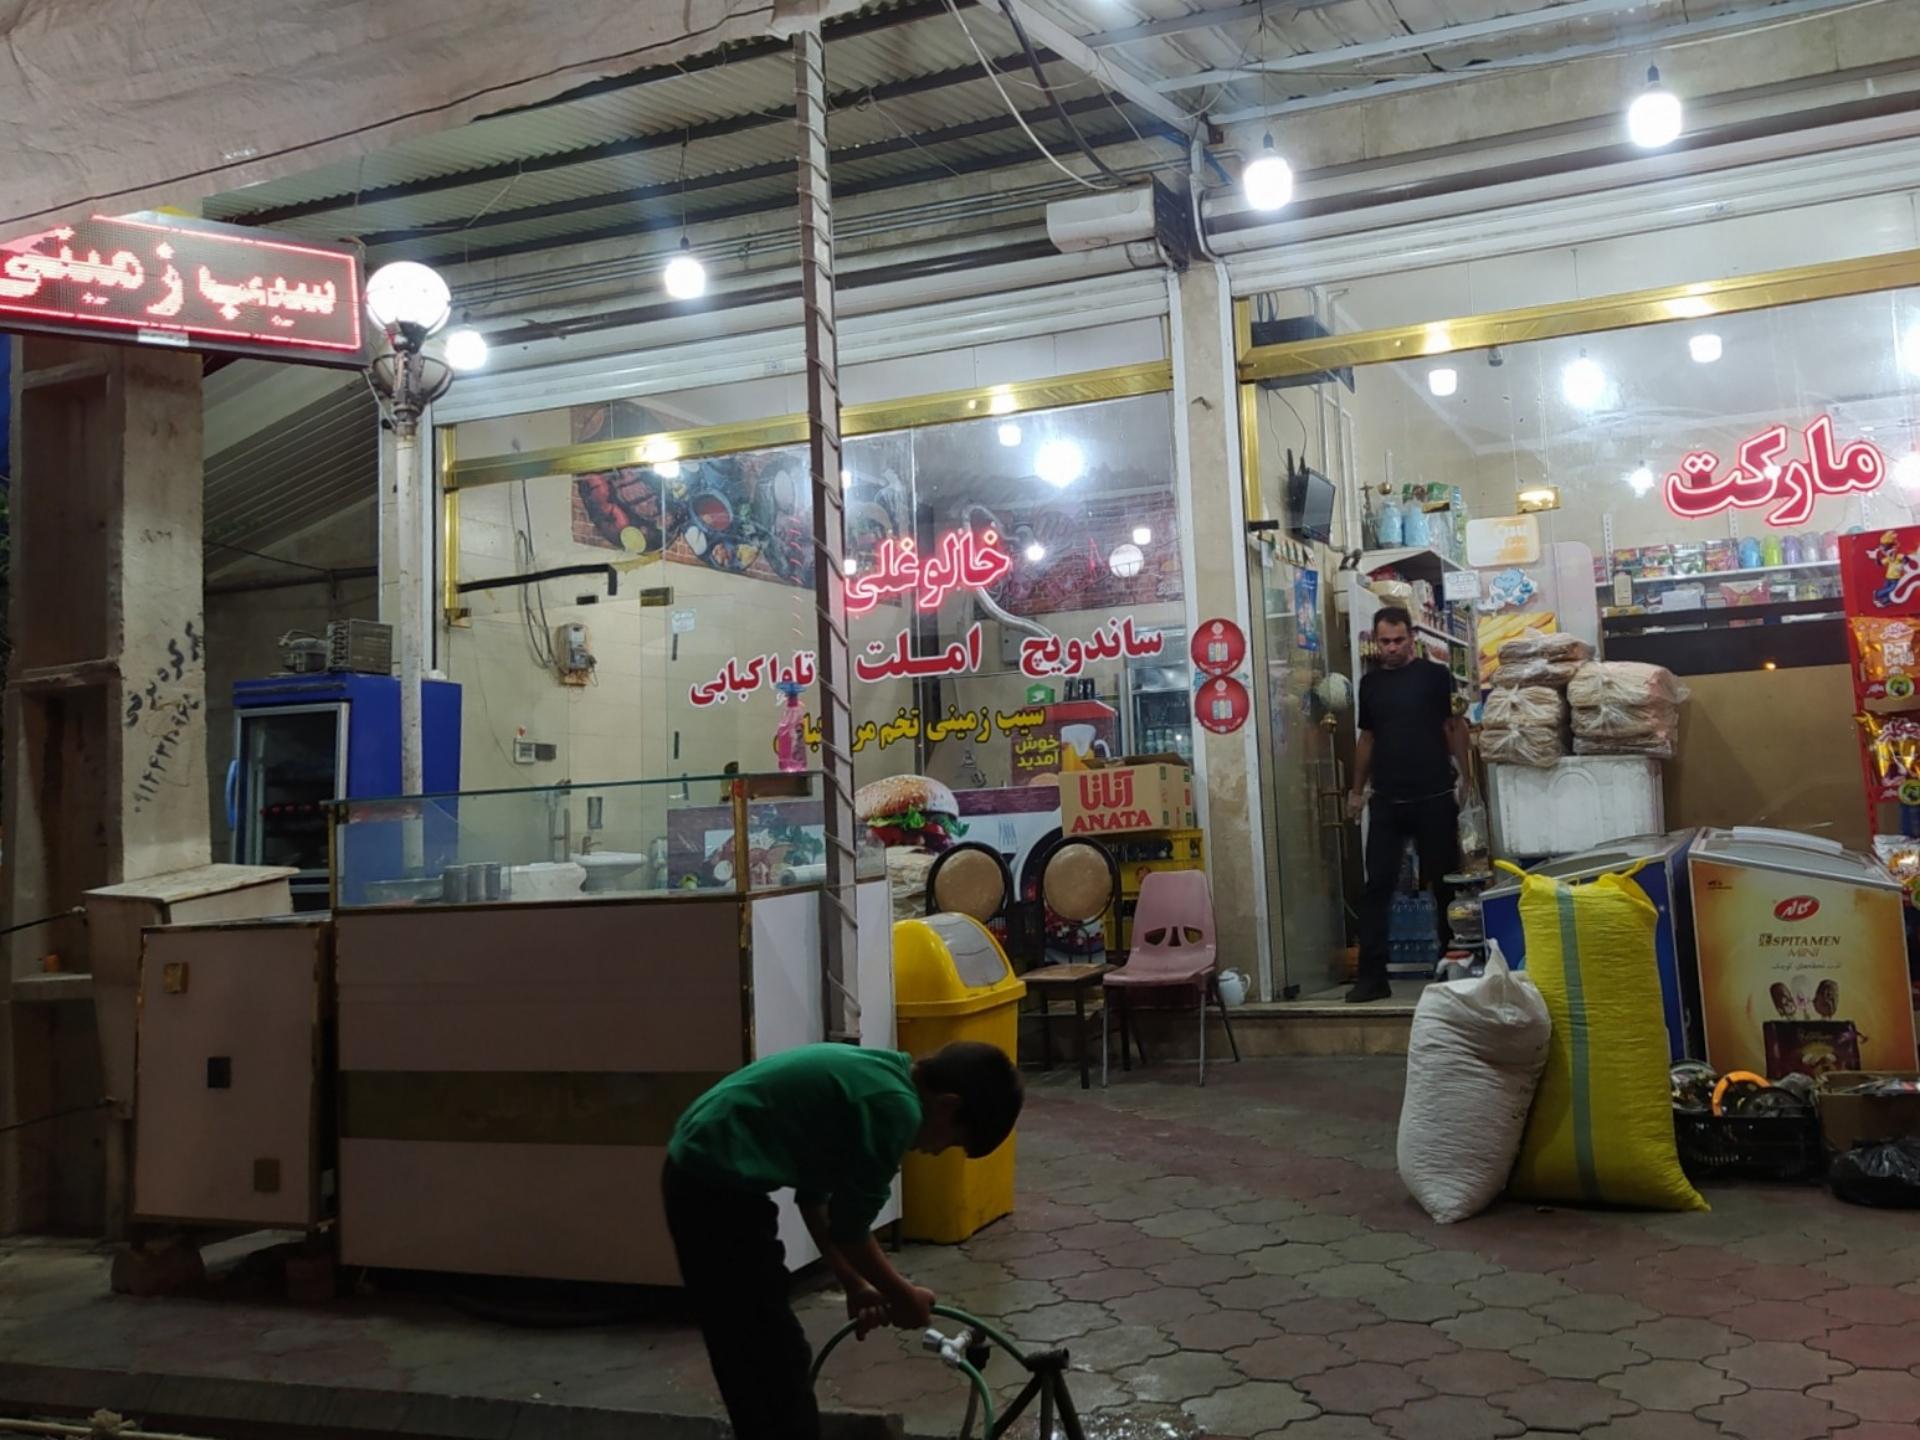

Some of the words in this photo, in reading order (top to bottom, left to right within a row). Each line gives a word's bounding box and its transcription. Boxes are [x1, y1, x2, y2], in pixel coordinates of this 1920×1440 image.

[198, 264, 336, 327] سیب
[1665, 416, 1885, 526] مارکت
[856, 622, 982, 682] املت
[1021, 616, 1164, 677] ساندویچ
[850, 720, 878, 753] مر
[880, 706, 922, 751] تخم
[926, 704, 991, 743] زمینی
[994, 704, 1046, 738] سیب
[1015, 735, 1061, 754] خوش
[1079, 769, 1135, 811] آناتا
[1070, 810, 1153, 834] ANATA
